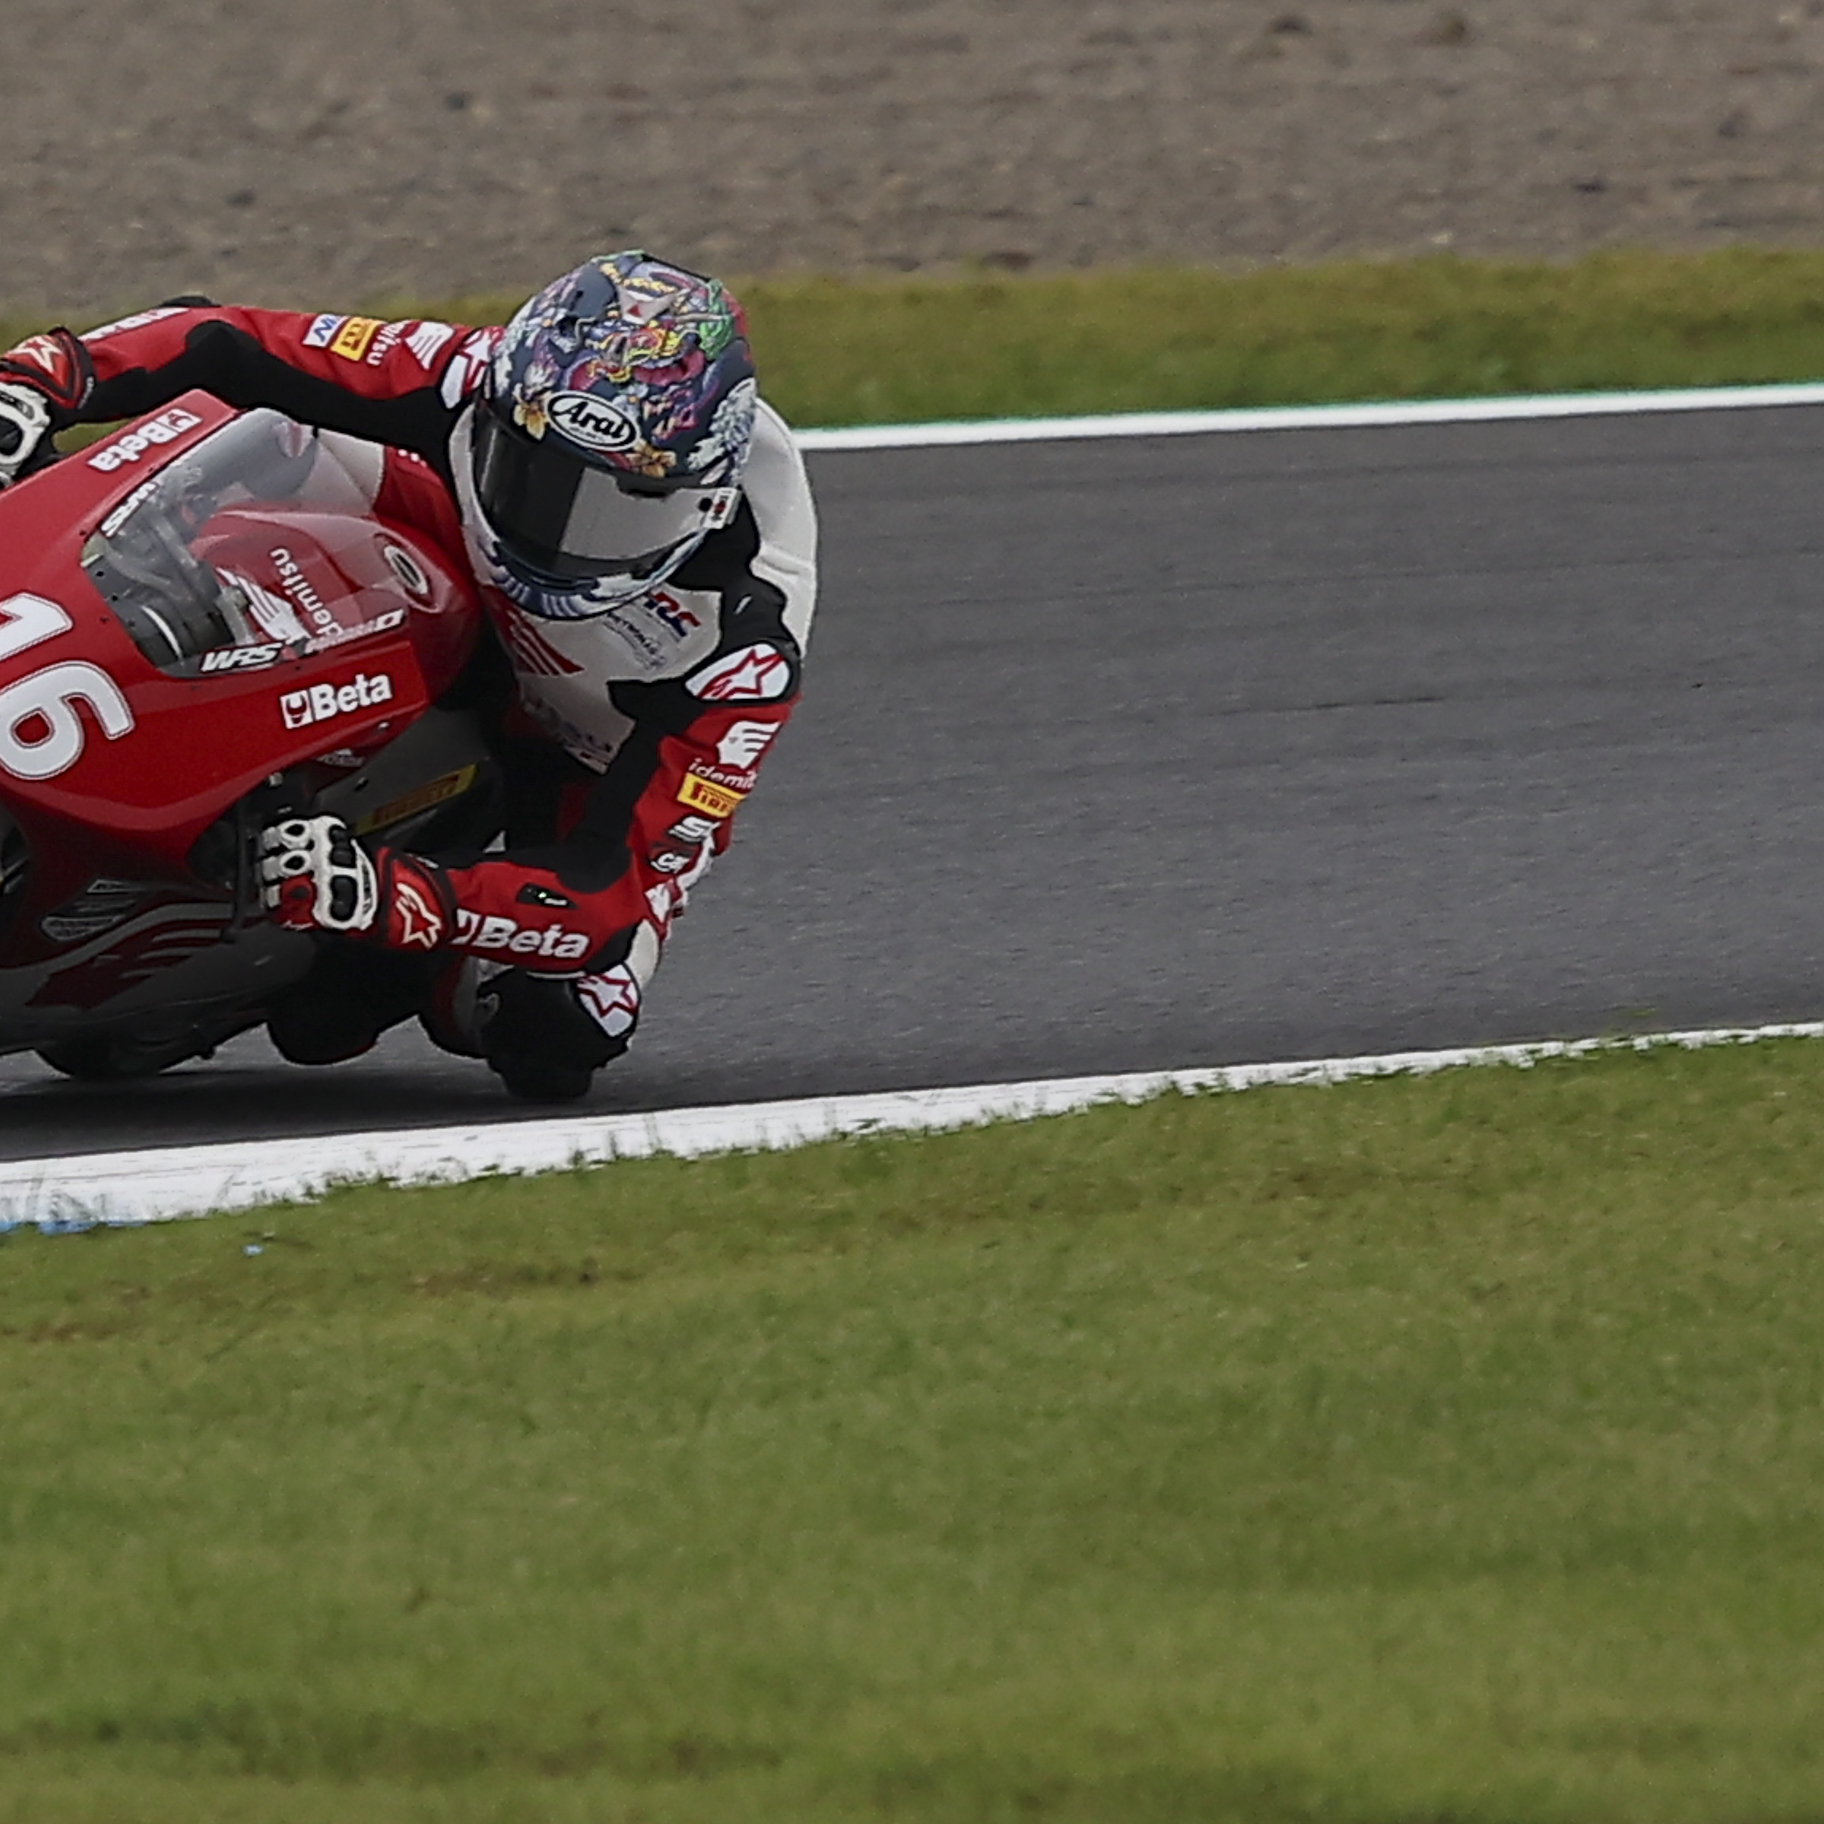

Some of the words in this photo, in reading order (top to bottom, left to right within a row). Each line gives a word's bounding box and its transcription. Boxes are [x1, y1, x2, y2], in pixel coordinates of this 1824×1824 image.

[88, 417, 174, 471] Beta
[552, 401, 628, 438] Arai
[101, 481, 159, 537] WRS
[271, 548, 344, 637] demitsu
[201, 643, 282, 672] WRS
[310, 673, 393, 724] Beta
[472, 915, 590, 959] Beta
